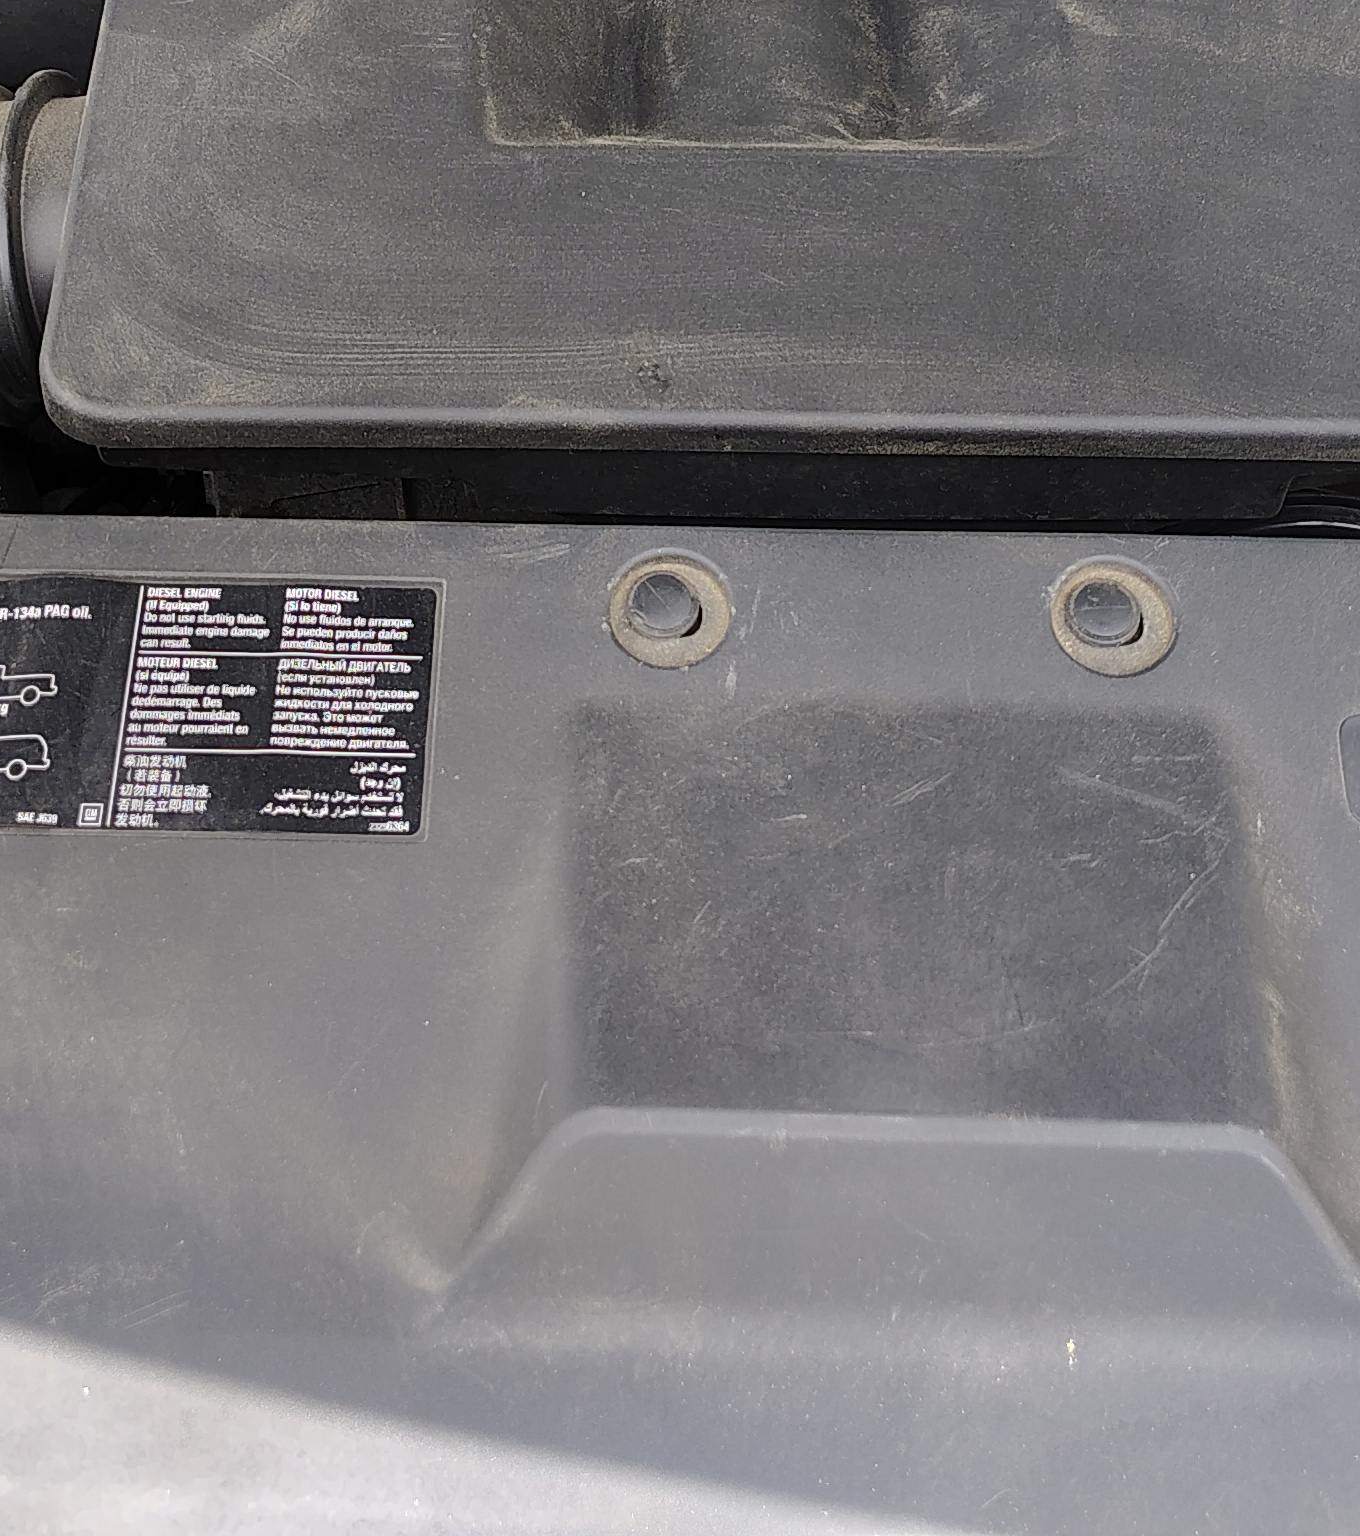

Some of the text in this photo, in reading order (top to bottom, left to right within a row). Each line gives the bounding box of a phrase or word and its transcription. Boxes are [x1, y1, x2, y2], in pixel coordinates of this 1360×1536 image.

[147, 587, 222, 599] DIESEL ENGINE
[286, 588, 359, 602] MOTOR DIESEL
[44, 605, 70, 618] PAG
[72, 606, 92, 620] oil.
[159, 600, 209, 613] Equipped)
[300, 601, 310, 611] lo
[312, 601, 342, 614] tiene)
[144, 613, 267, 626] Do not use starting fluids.
[283, 614, 414, 629] No use fluidos de arranque.
[142, 625, 270, 639] Immediate engine damage
[282, 626, 408, 640] Se pueden producir daños
[140, 638, 191, 648] can result.
[280, 640, 393, 652] inmediatos en el motor.
[137, 657, 218, 669] MOTEUR DIESEL
[277, 658, 411, 673] ДИЗЕЛЬНЫЙ ДВИГАТЕЛЬ
[277, 672, 307, 683] (если
[133, 683, 256, 696] Ne pas utiliser de liquide
[202, 697, 222, 708] Des
[331, 700, 352, 711] для
[130, 710, 240, 722] dommages immédiats
[323, 712, 344, 723] Это
[127, 723, 249, 735] au moteur pourraient en
[126, 735, 167, 746] résulter.
[15, 812, 34, 823] SAE
